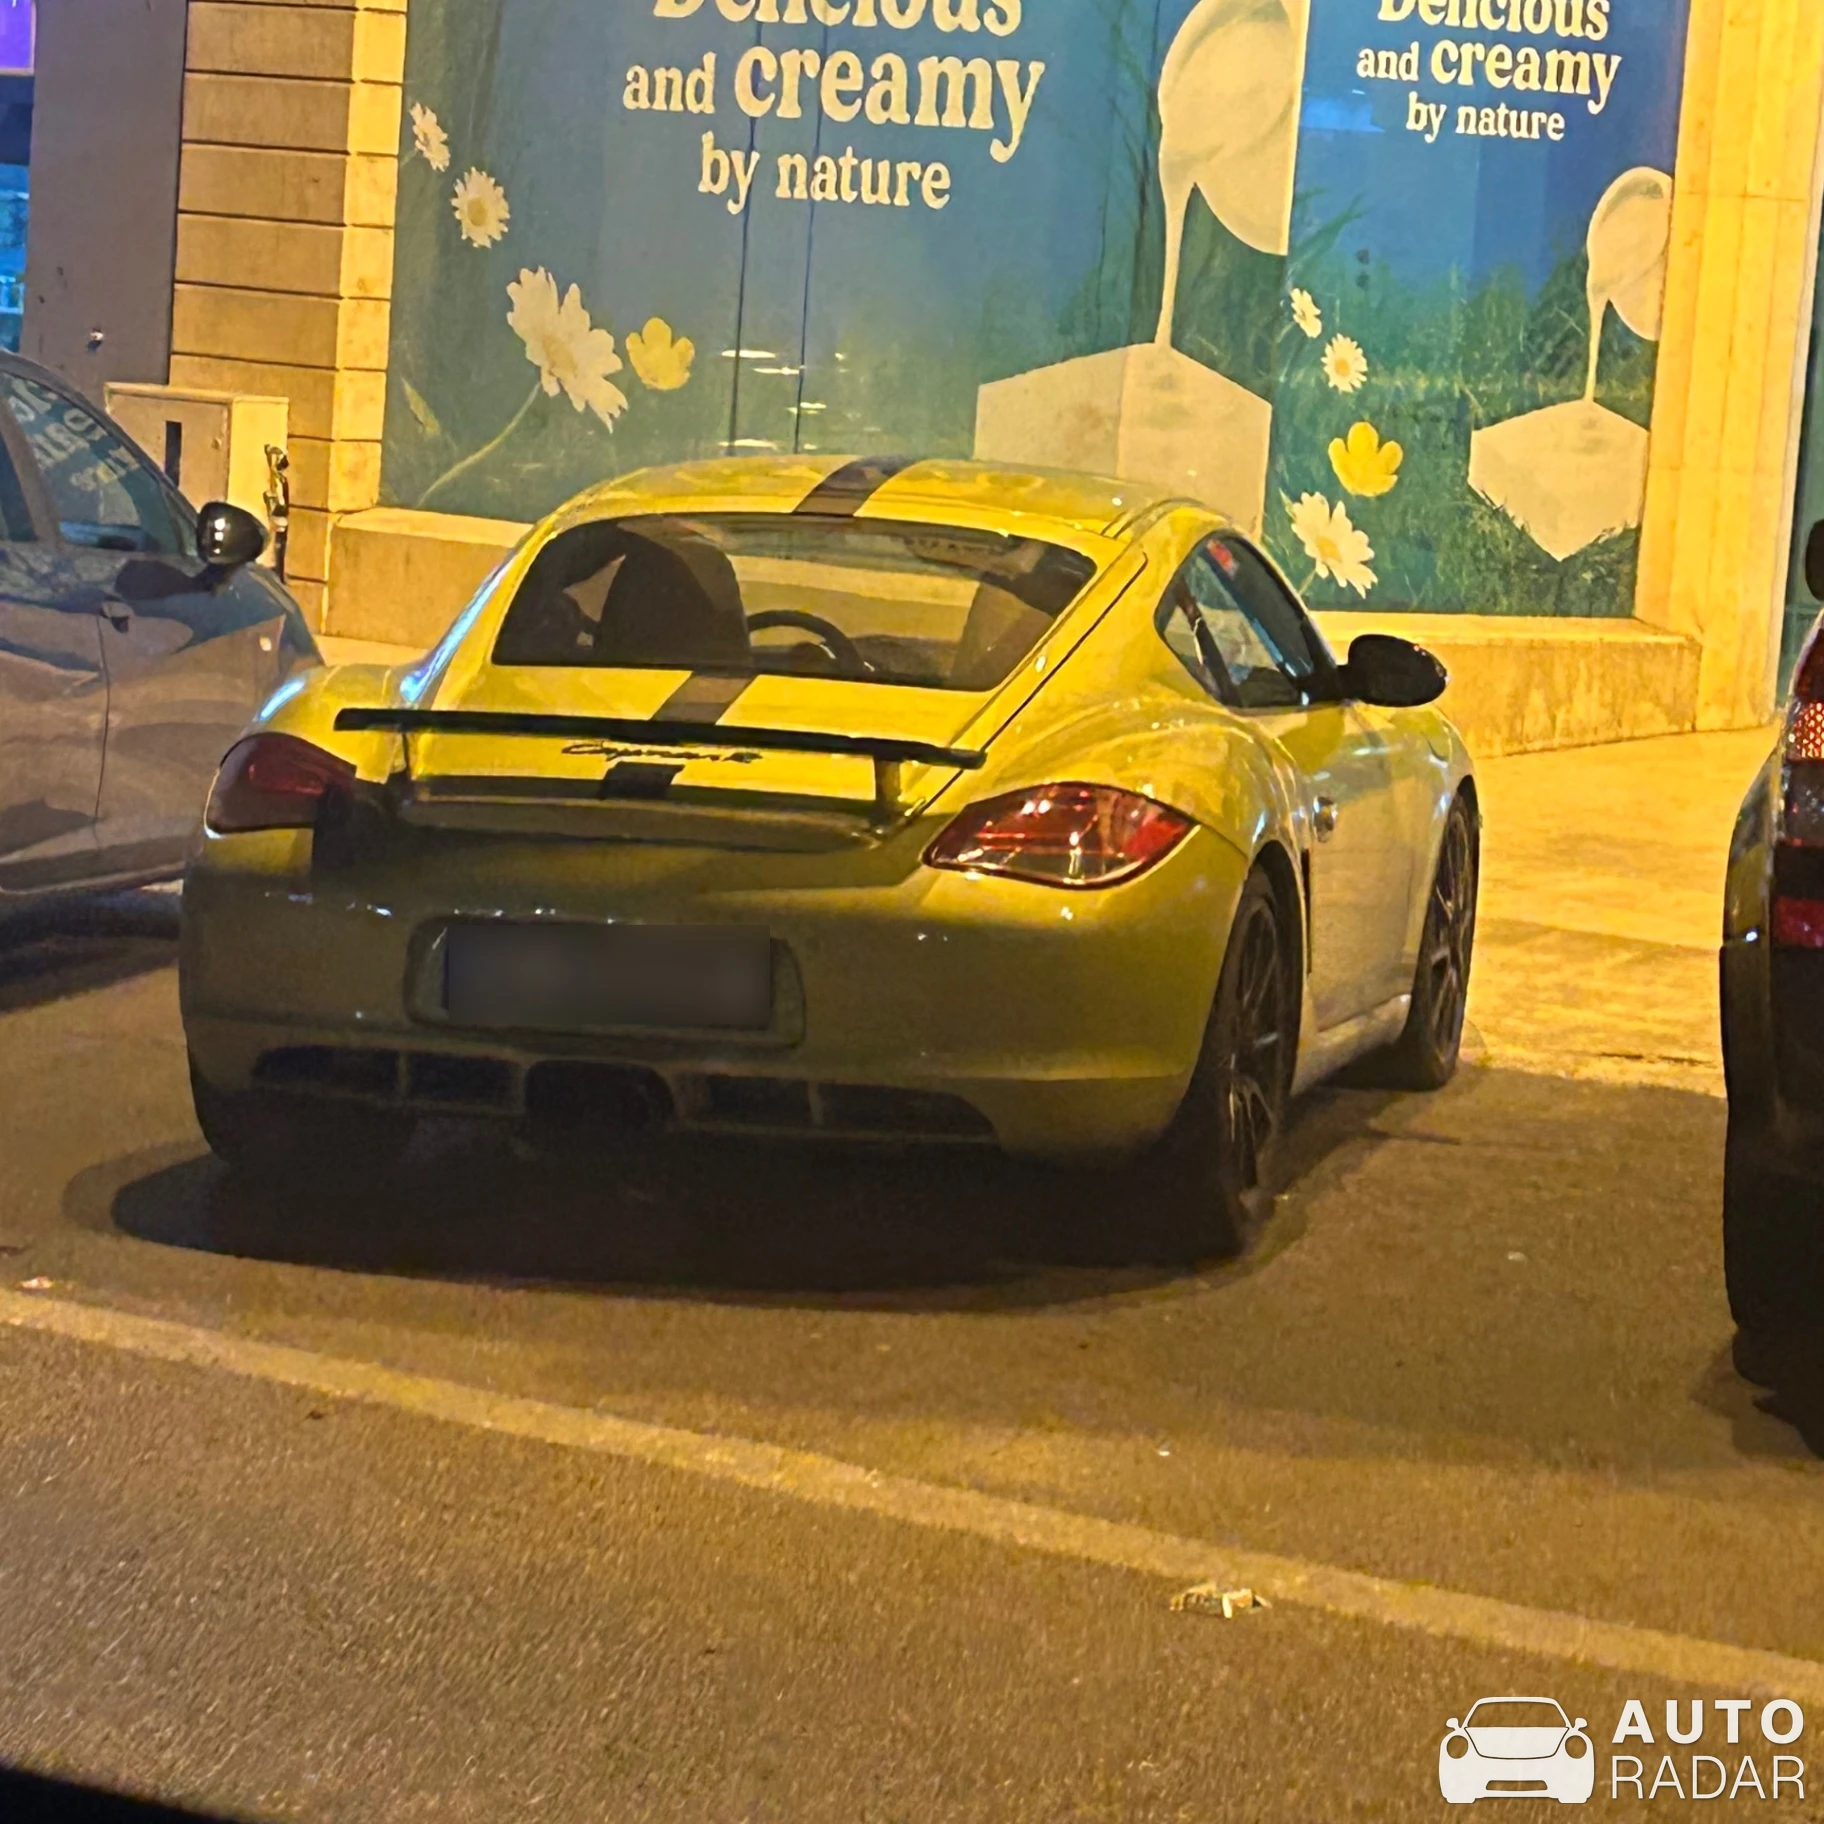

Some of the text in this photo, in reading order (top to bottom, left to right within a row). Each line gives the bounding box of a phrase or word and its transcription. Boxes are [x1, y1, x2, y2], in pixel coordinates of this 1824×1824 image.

[622, 45, 1046, 163] and creamy
[1356, 39, 1623, 115] and creamy
[1405, 91, 1566, 144] by nature
[697, 131, 952, 215] by nature
